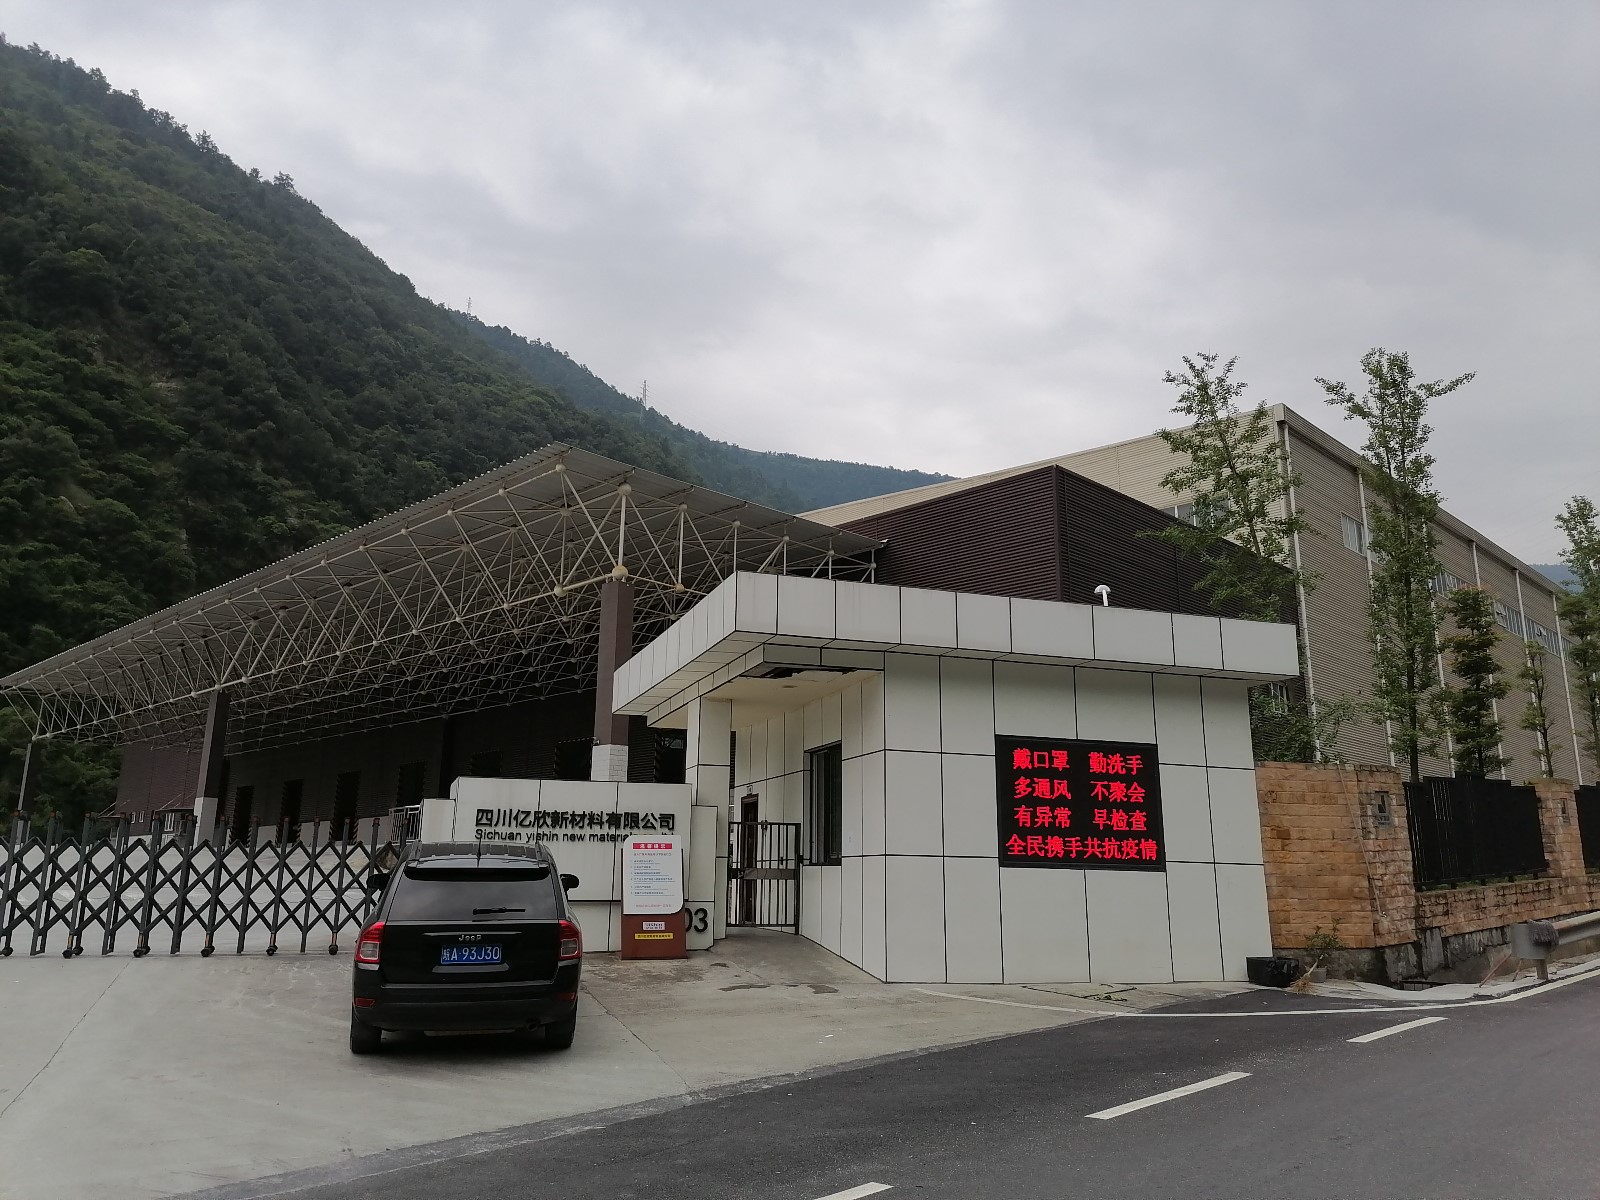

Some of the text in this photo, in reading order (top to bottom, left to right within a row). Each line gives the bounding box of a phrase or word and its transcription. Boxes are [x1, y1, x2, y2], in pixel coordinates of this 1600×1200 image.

[1012, 747, 1144, 776] 戴口罩 勤洗手
[1013, 776, 1146, 803] 多通风 不聚会
[475, 808, 675, 830] 四川亿欣新材料有限公司
[1014, 804, 1147, 831] 有异常 早检查
[474, 829, 522, 842] Sichuan
[562, 833, 586, 843] new
[589, 831, 633, 844] materia
[1005, 833, 1158, 861] 全民携手共抗疫情
